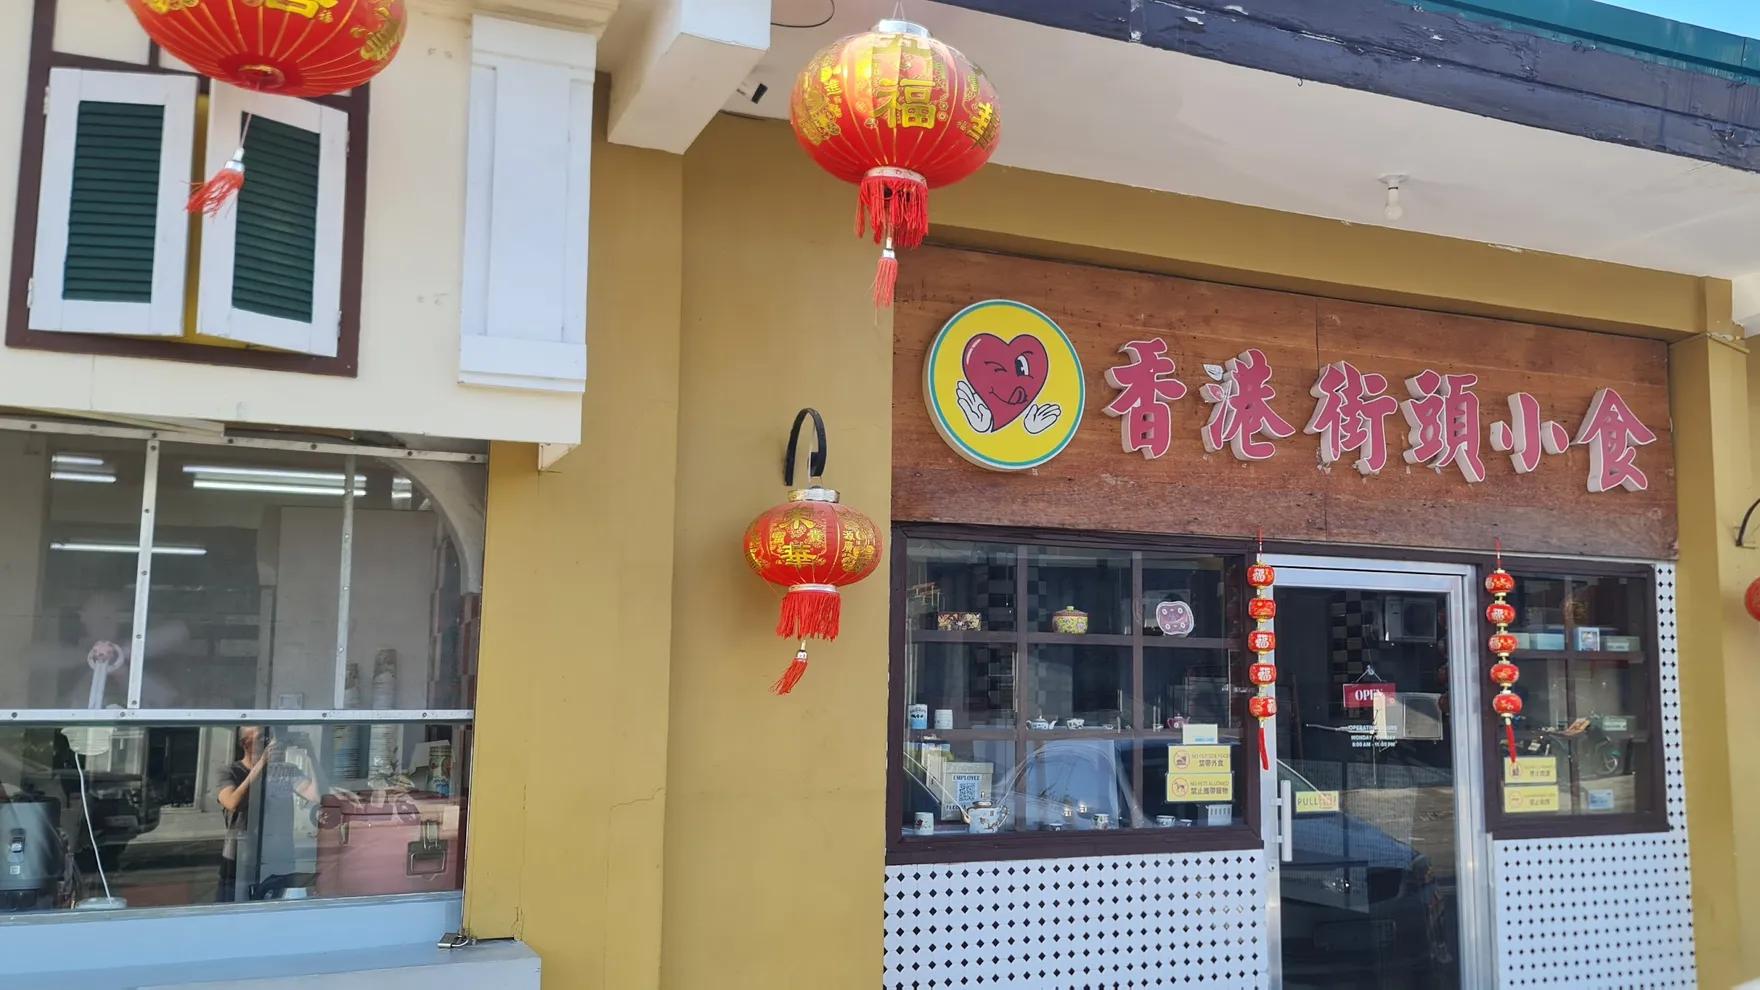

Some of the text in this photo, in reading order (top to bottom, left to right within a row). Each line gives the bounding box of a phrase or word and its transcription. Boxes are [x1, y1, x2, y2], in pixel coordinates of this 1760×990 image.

[873, 80, 936, 129] 福
[1102, 336, 1657, 493] 香港街頭小食
[1355, 689, 1383, 701] OPEN
[1297, 796, 1318, 806] PULL
